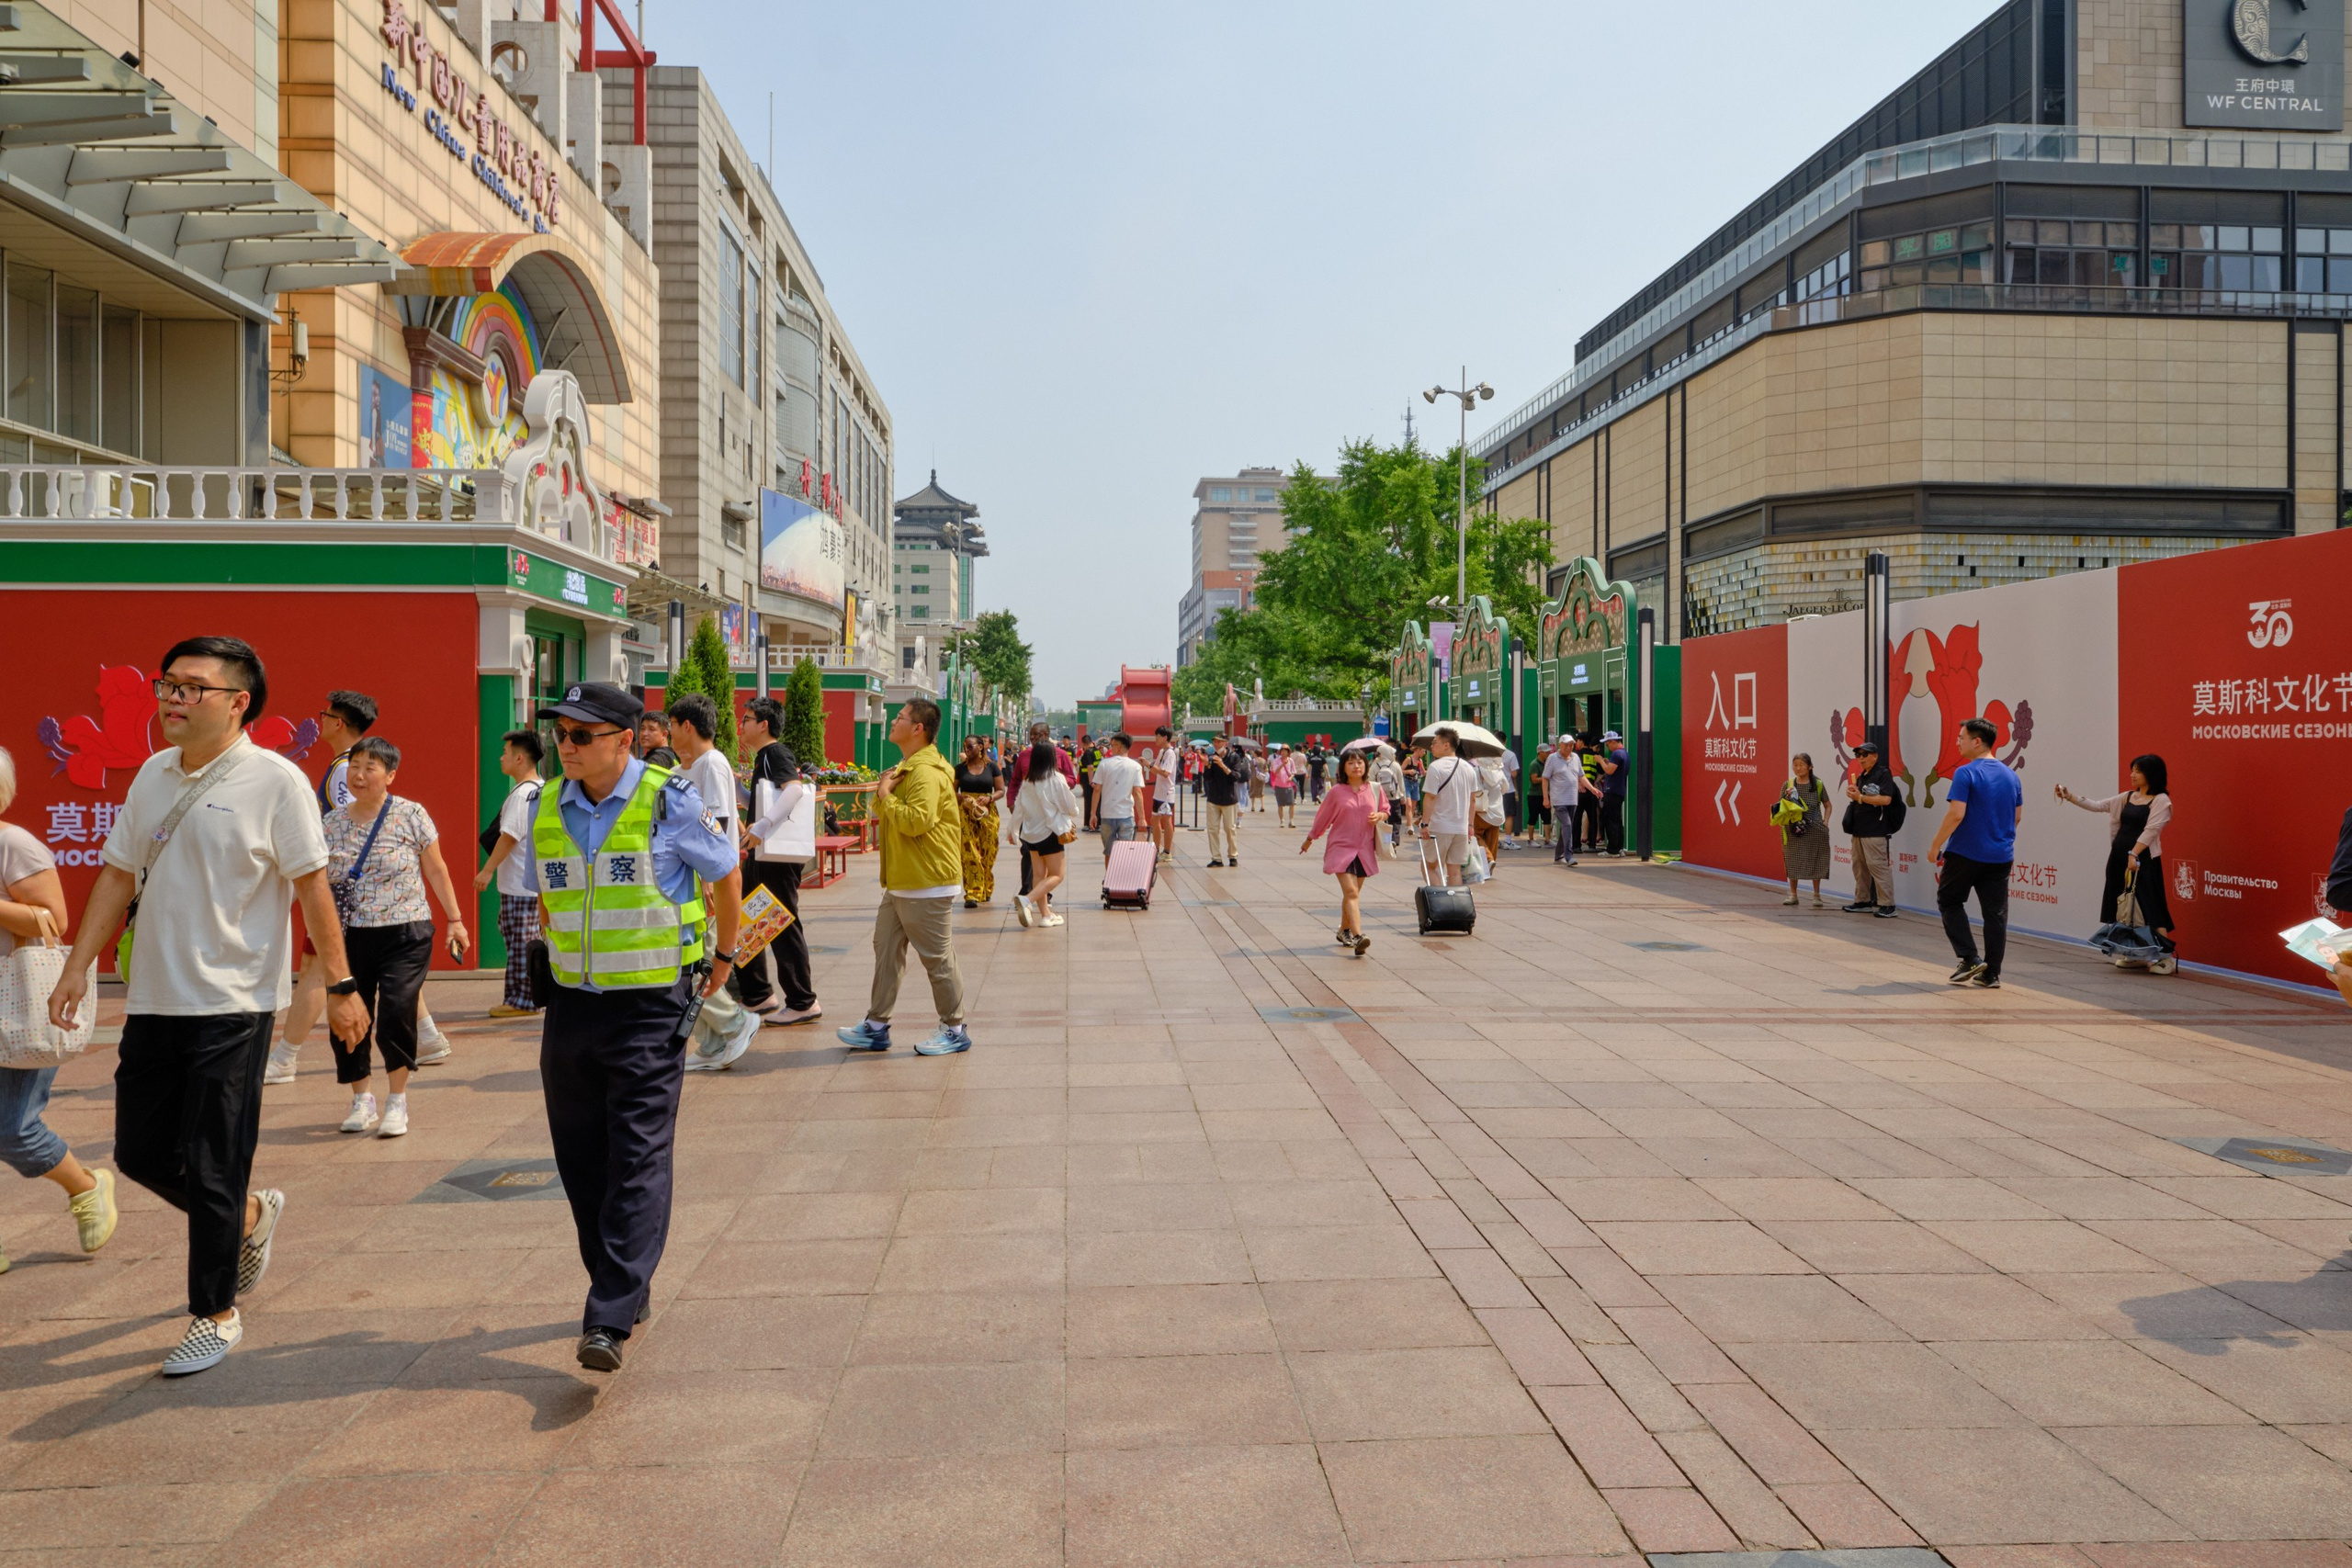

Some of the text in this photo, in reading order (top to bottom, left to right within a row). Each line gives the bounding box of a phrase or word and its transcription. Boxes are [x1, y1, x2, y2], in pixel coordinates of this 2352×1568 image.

[2235, 78, 2295, 94] 王府中環
[2207, 96, 2324, 112] WF CENTRAL
[381, 62, 529, 221] New China Children's
[1705, 671, 1757, 730] 入口
[2193, 672, 2352, 716] 莫斯科文化节
[2193, 724, 2290, 739] МОСКОВСКИЕ
[1705, 738, 1757, 760] 莫斯科文化节
[1705, 762, 1736, 772] МОСКОВСКИЕ
[2204, 870, 2278, 890] Правительство
[2026, 891, 2058, 905] СЕЗОНЫ
[2204, 884, 2243, 899] Москвы
